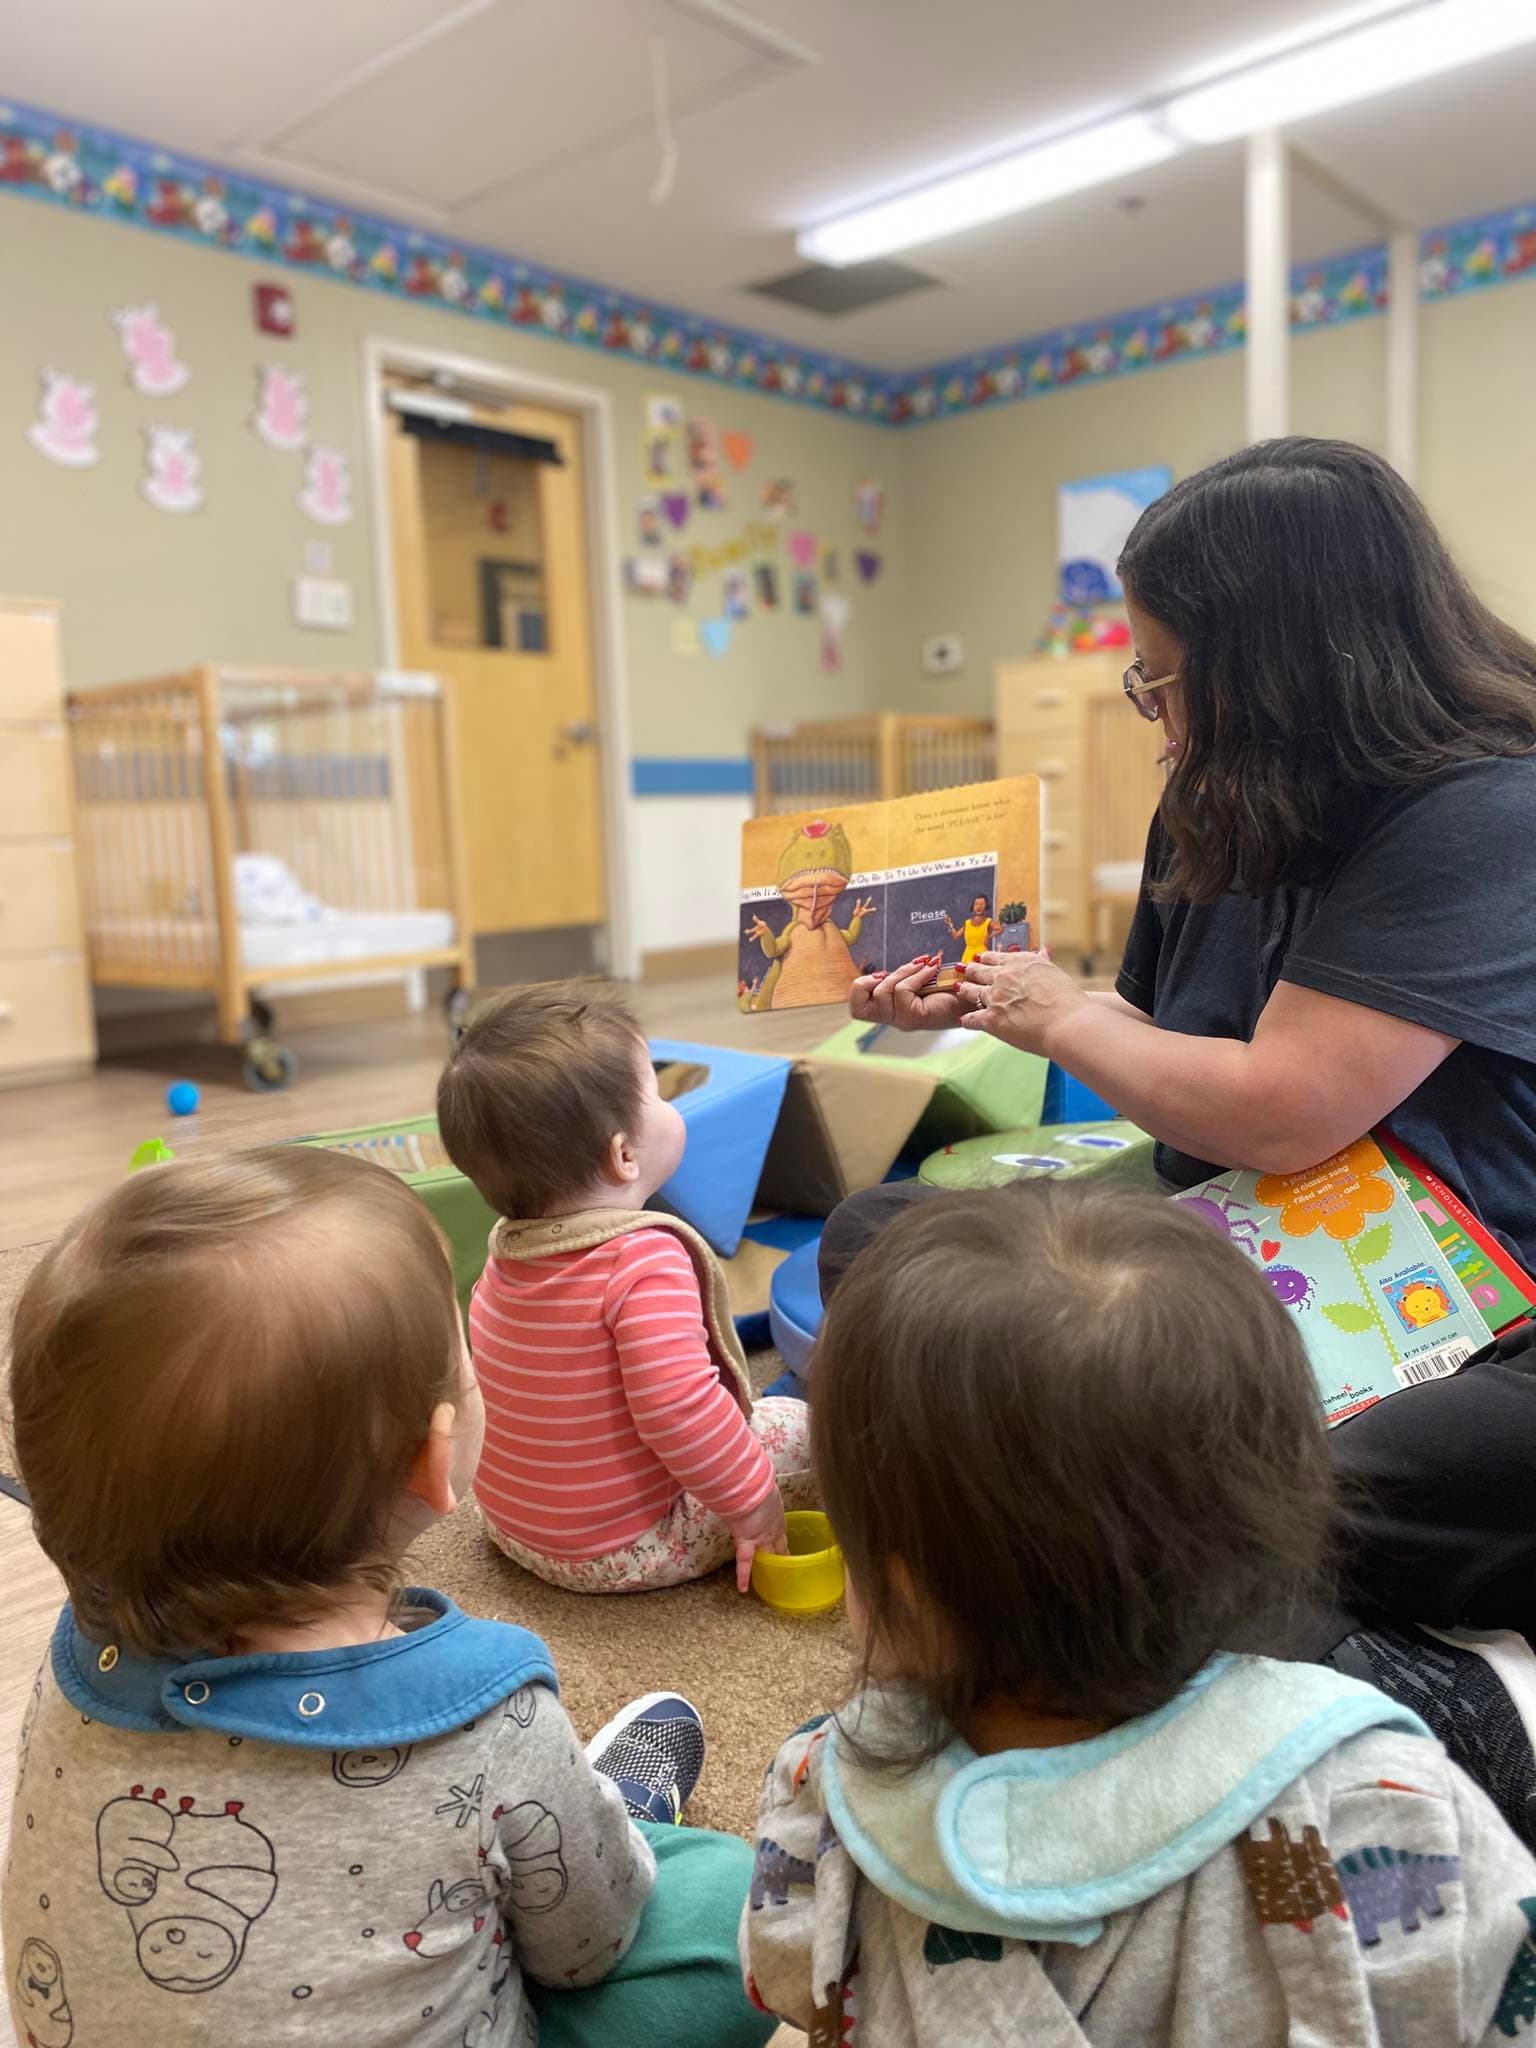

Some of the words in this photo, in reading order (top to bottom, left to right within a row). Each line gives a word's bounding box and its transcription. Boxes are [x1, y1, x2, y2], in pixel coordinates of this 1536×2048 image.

[910, 908, 947, 923] Please
[1300, 1174, 1329, 1192] classic
[1329, 1164, 1350, 1179] song
[1293, 1190, 1316, 1206] filled
[1316, 1182, 1334, 1196] with
[1343, 1181, 1360, 1195] and
[1431, 1179, 1474, 1227] SCHOLASTIC
[1378, 1275, 1394, 1286] Also
[1403, 1346, 1420, 1359] $7.99
[1322, 1390, 1348, 1406] twheel
[1349, 1384, 1374, 1400] books
